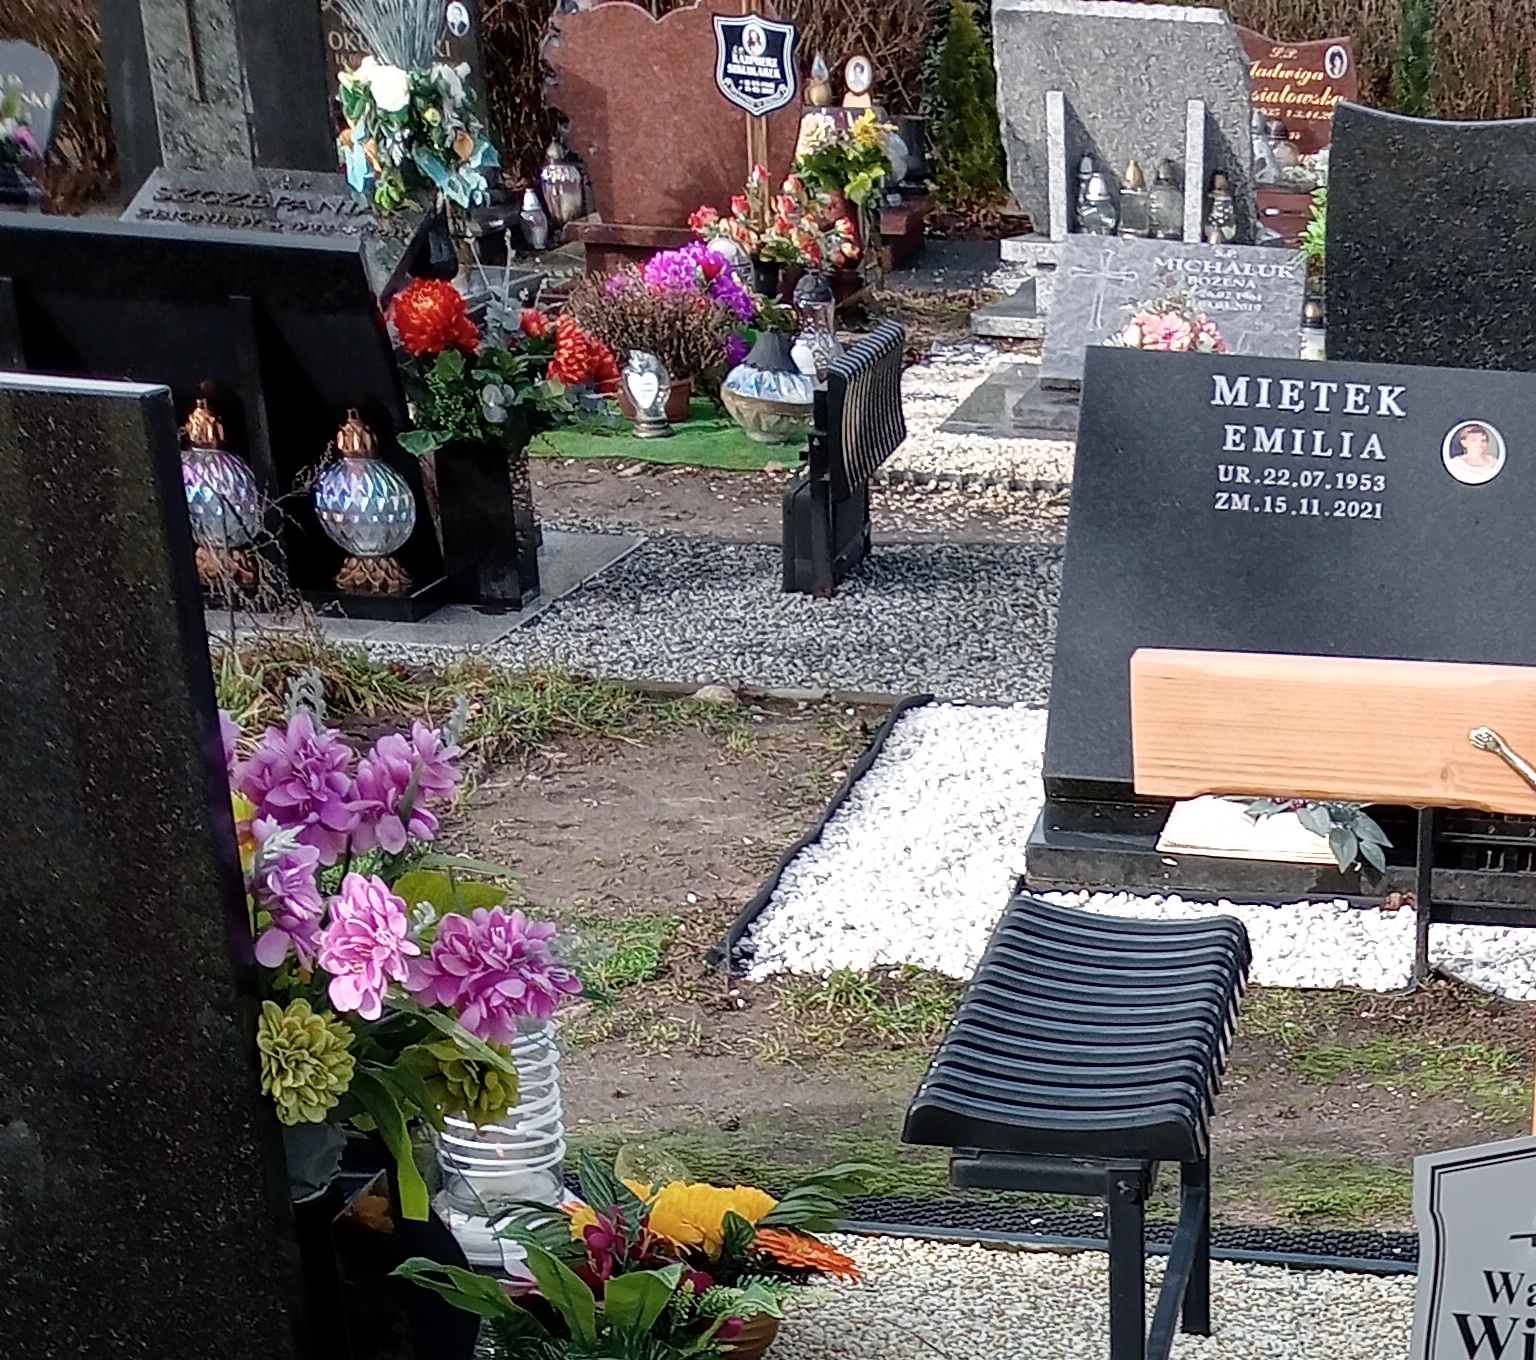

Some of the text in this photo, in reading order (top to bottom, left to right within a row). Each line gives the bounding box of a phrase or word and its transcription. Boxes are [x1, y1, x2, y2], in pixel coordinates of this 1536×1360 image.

[1210, 374, 1407, 417] MIĘTEK
[1222, 424, 1386, 460] EMILIA
[1217, 464, 1386, 492] UR.22.07.1953
[1214, 492, 1383, 519] ZM.15.11.2021
